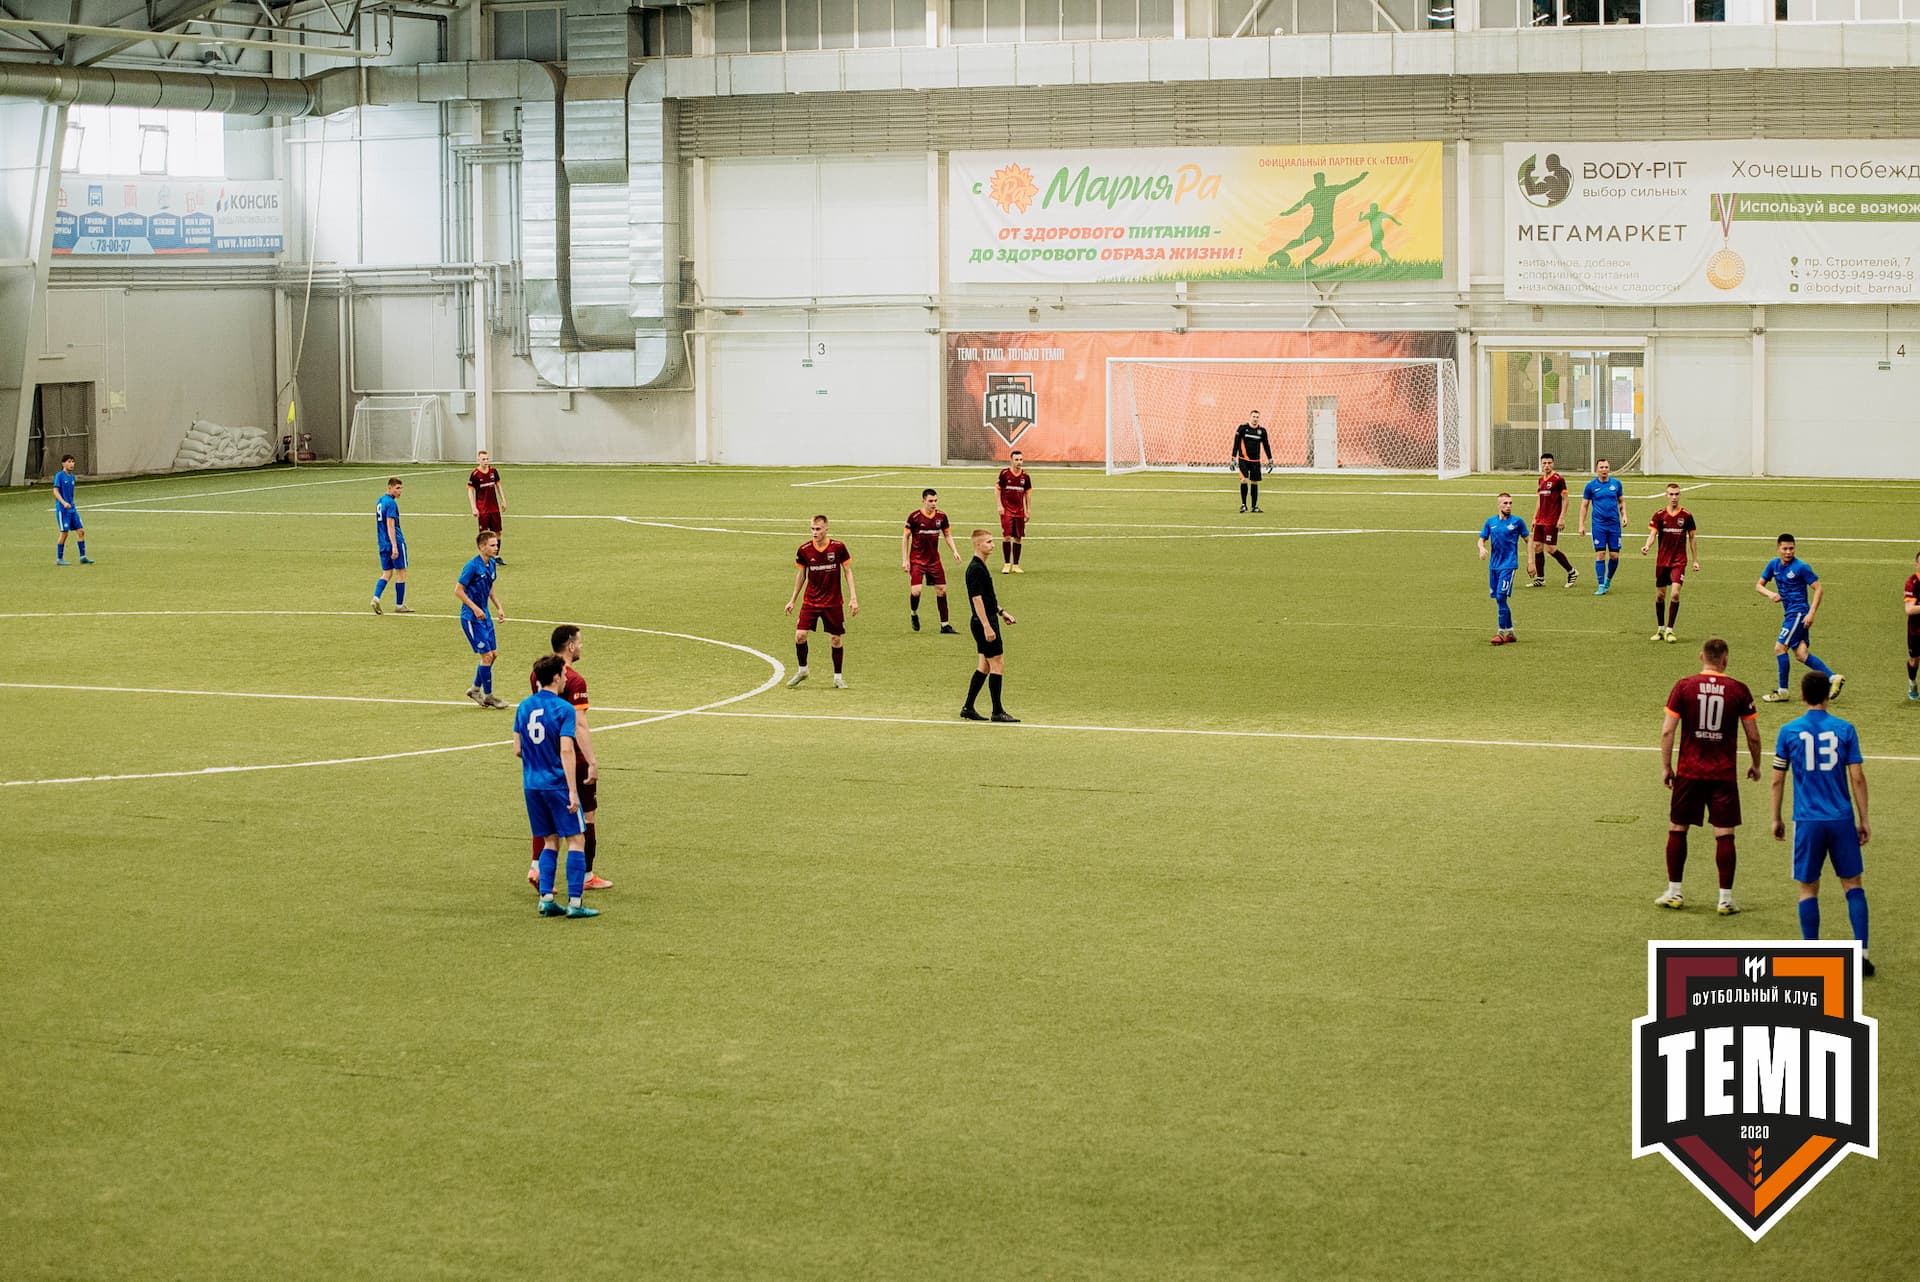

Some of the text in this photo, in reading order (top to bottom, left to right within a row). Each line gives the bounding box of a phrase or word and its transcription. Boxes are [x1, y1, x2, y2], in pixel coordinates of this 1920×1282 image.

[1259, 156, 1414, 168] ОФИЦИАЛЬНЫЙ ПАРТНЕР СК «ТЕМП»
[1732, 160, 1822, 178] Хочешь
[1583, 162, 1687, 179] BODY-PIT
[1583, 186, 1687, 197] выбор сильных
[231, 195, 278, 209] КОНСИБ
[1740, 200, 1824, 215] Используй
[1829, 202, 1856, 213] все
[999, 228, 1020, 240] ОТ
[1023, 227, 1124, 242] ЗДОРОВОГО
[1128, 226, 1210, 238] ПИТАНИЯ
[1518, 225, 1687, 241] МЕГАМАРКЕТ
[96, 240, 131, 252] 73-00-37
[969, 249, 993, 263] ДО
[996, 249, 1097, 262] ЗДОРОВОГО
[1100, 248, 1165, 260] ОБРАЗА
[1169, 247, 1235, 260] ЖИЗНИ
[1584, 258, 1632, 268] добавок
[1804, 257, 1911, 268] пр. Строителей, 7
[1594, 272, 1640, 280] питания
[1804, 270, 1914, 280] +7-903-949-949-8
[1804, 283, 1912, 294] @bodypit_barnaul
[818, 342, 826, 355] 3
[957, 348, 980, 361] ТЕМП,
[983, 348, 1005, 361] ТЕМП,
[1008, 348, 1039, 360] ТОЛЬКО
[1896, 344, 1906, 358] 4
[989, 393, 1033, 420] ТЕМП
[1697, 694, 1725, 731] 10
[527, 709, 545, 745] 6
[1799, 731, 1838, 771] 13
